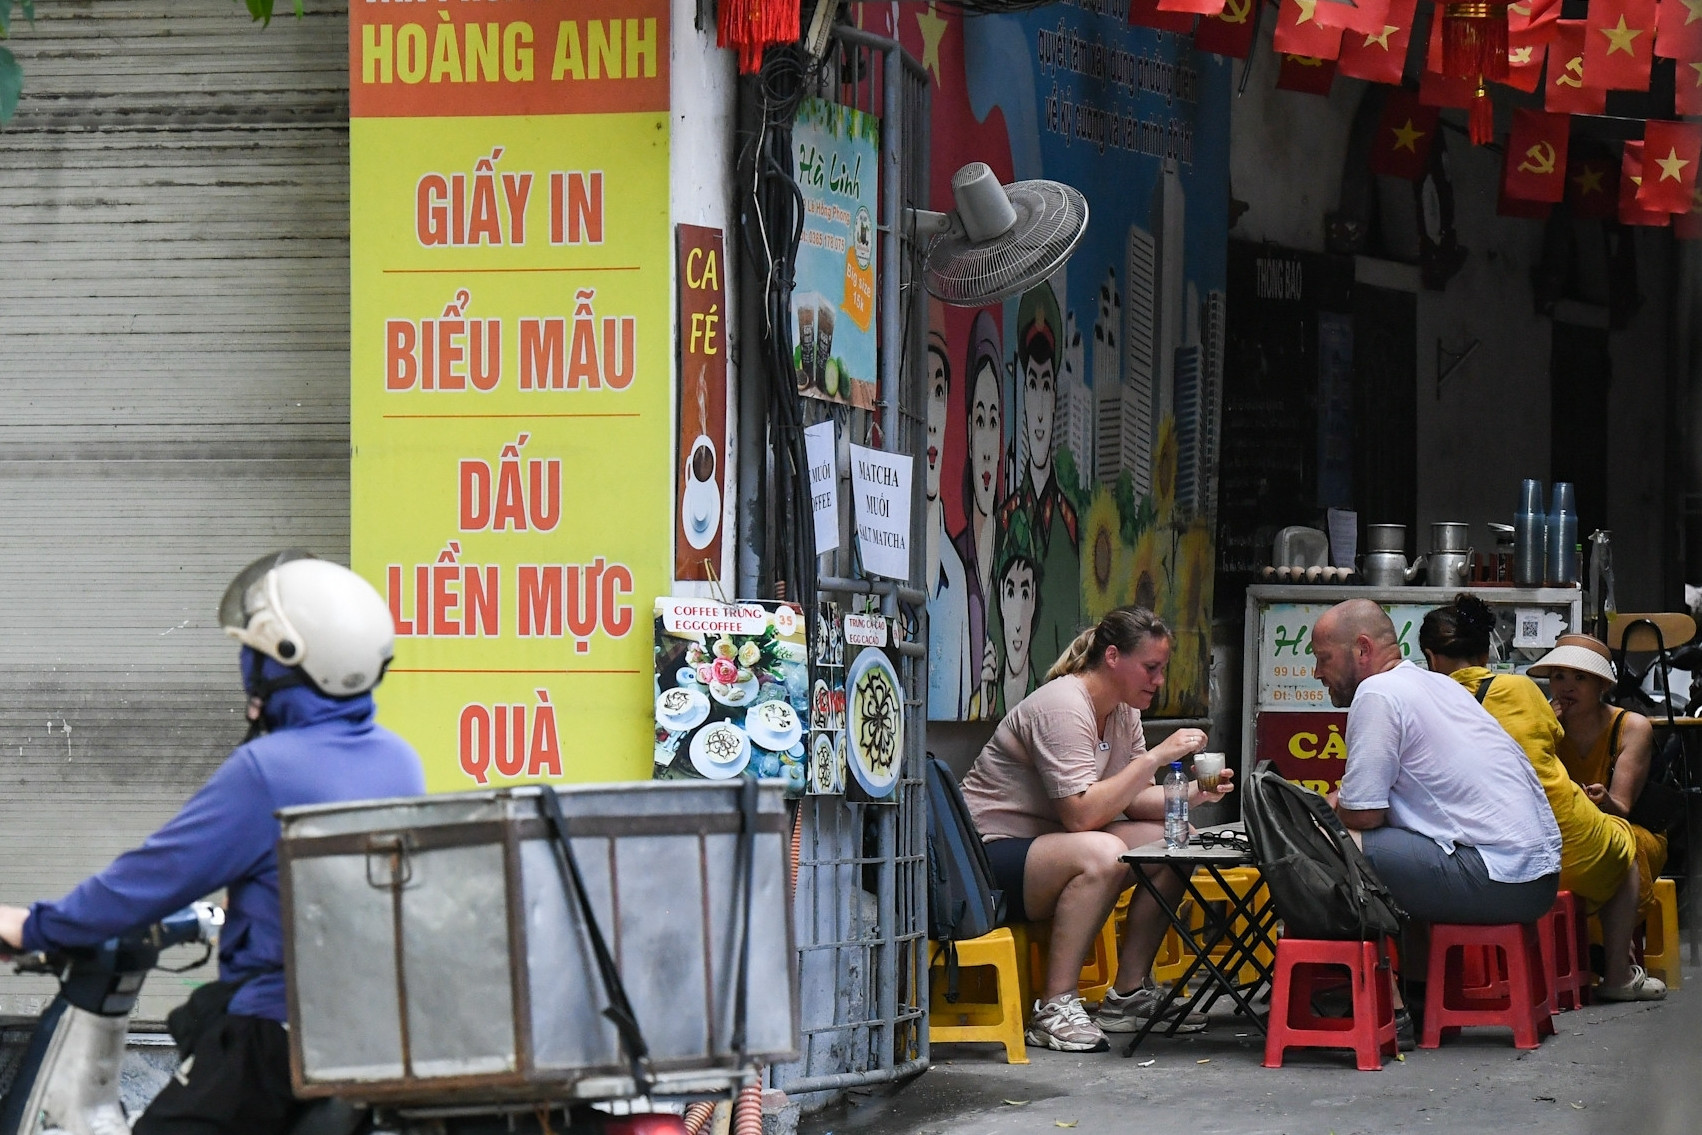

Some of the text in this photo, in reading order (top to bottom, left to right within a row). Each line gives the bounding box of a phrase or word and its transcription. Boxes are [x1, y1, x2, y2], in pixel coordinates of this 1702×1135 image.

[362, 10, 657, 84] HOÀNG ANH
[799, 143, 861, 199] Hà Linh
[416, 146, 604, 246] GIẤY IN
[687, 248, 718, 291] CA
[846, 263, 871, 298] Big size
[385, 288, 635, 391] BIỂU MẪU
[689, 304, 718, 355] FÉ
[459, 432, 561, 532] DẤU
[858, 460, 899, 487] MATCHA
[866, 493, 890, 518] MUỐI
[873, 529, 905, 549] MATCHA
[387, 541, 633, 654] LIỀN MỰC
[674, 606, 718, 617] COFFEE
[675, 620, 742, 632] EGGCOFFEE
[779, 615, 793, 626] 35
[850, 634, 861, 643] EGG
[1274, 667, 1288, 677] 99
[1293, 666, 1307, 677] Lê
[1274, 690, 1324, 701] Đt: 0365
[459, 688, 563, 785] QUÀ
[1288, 724, 1347, 759] CÀ
